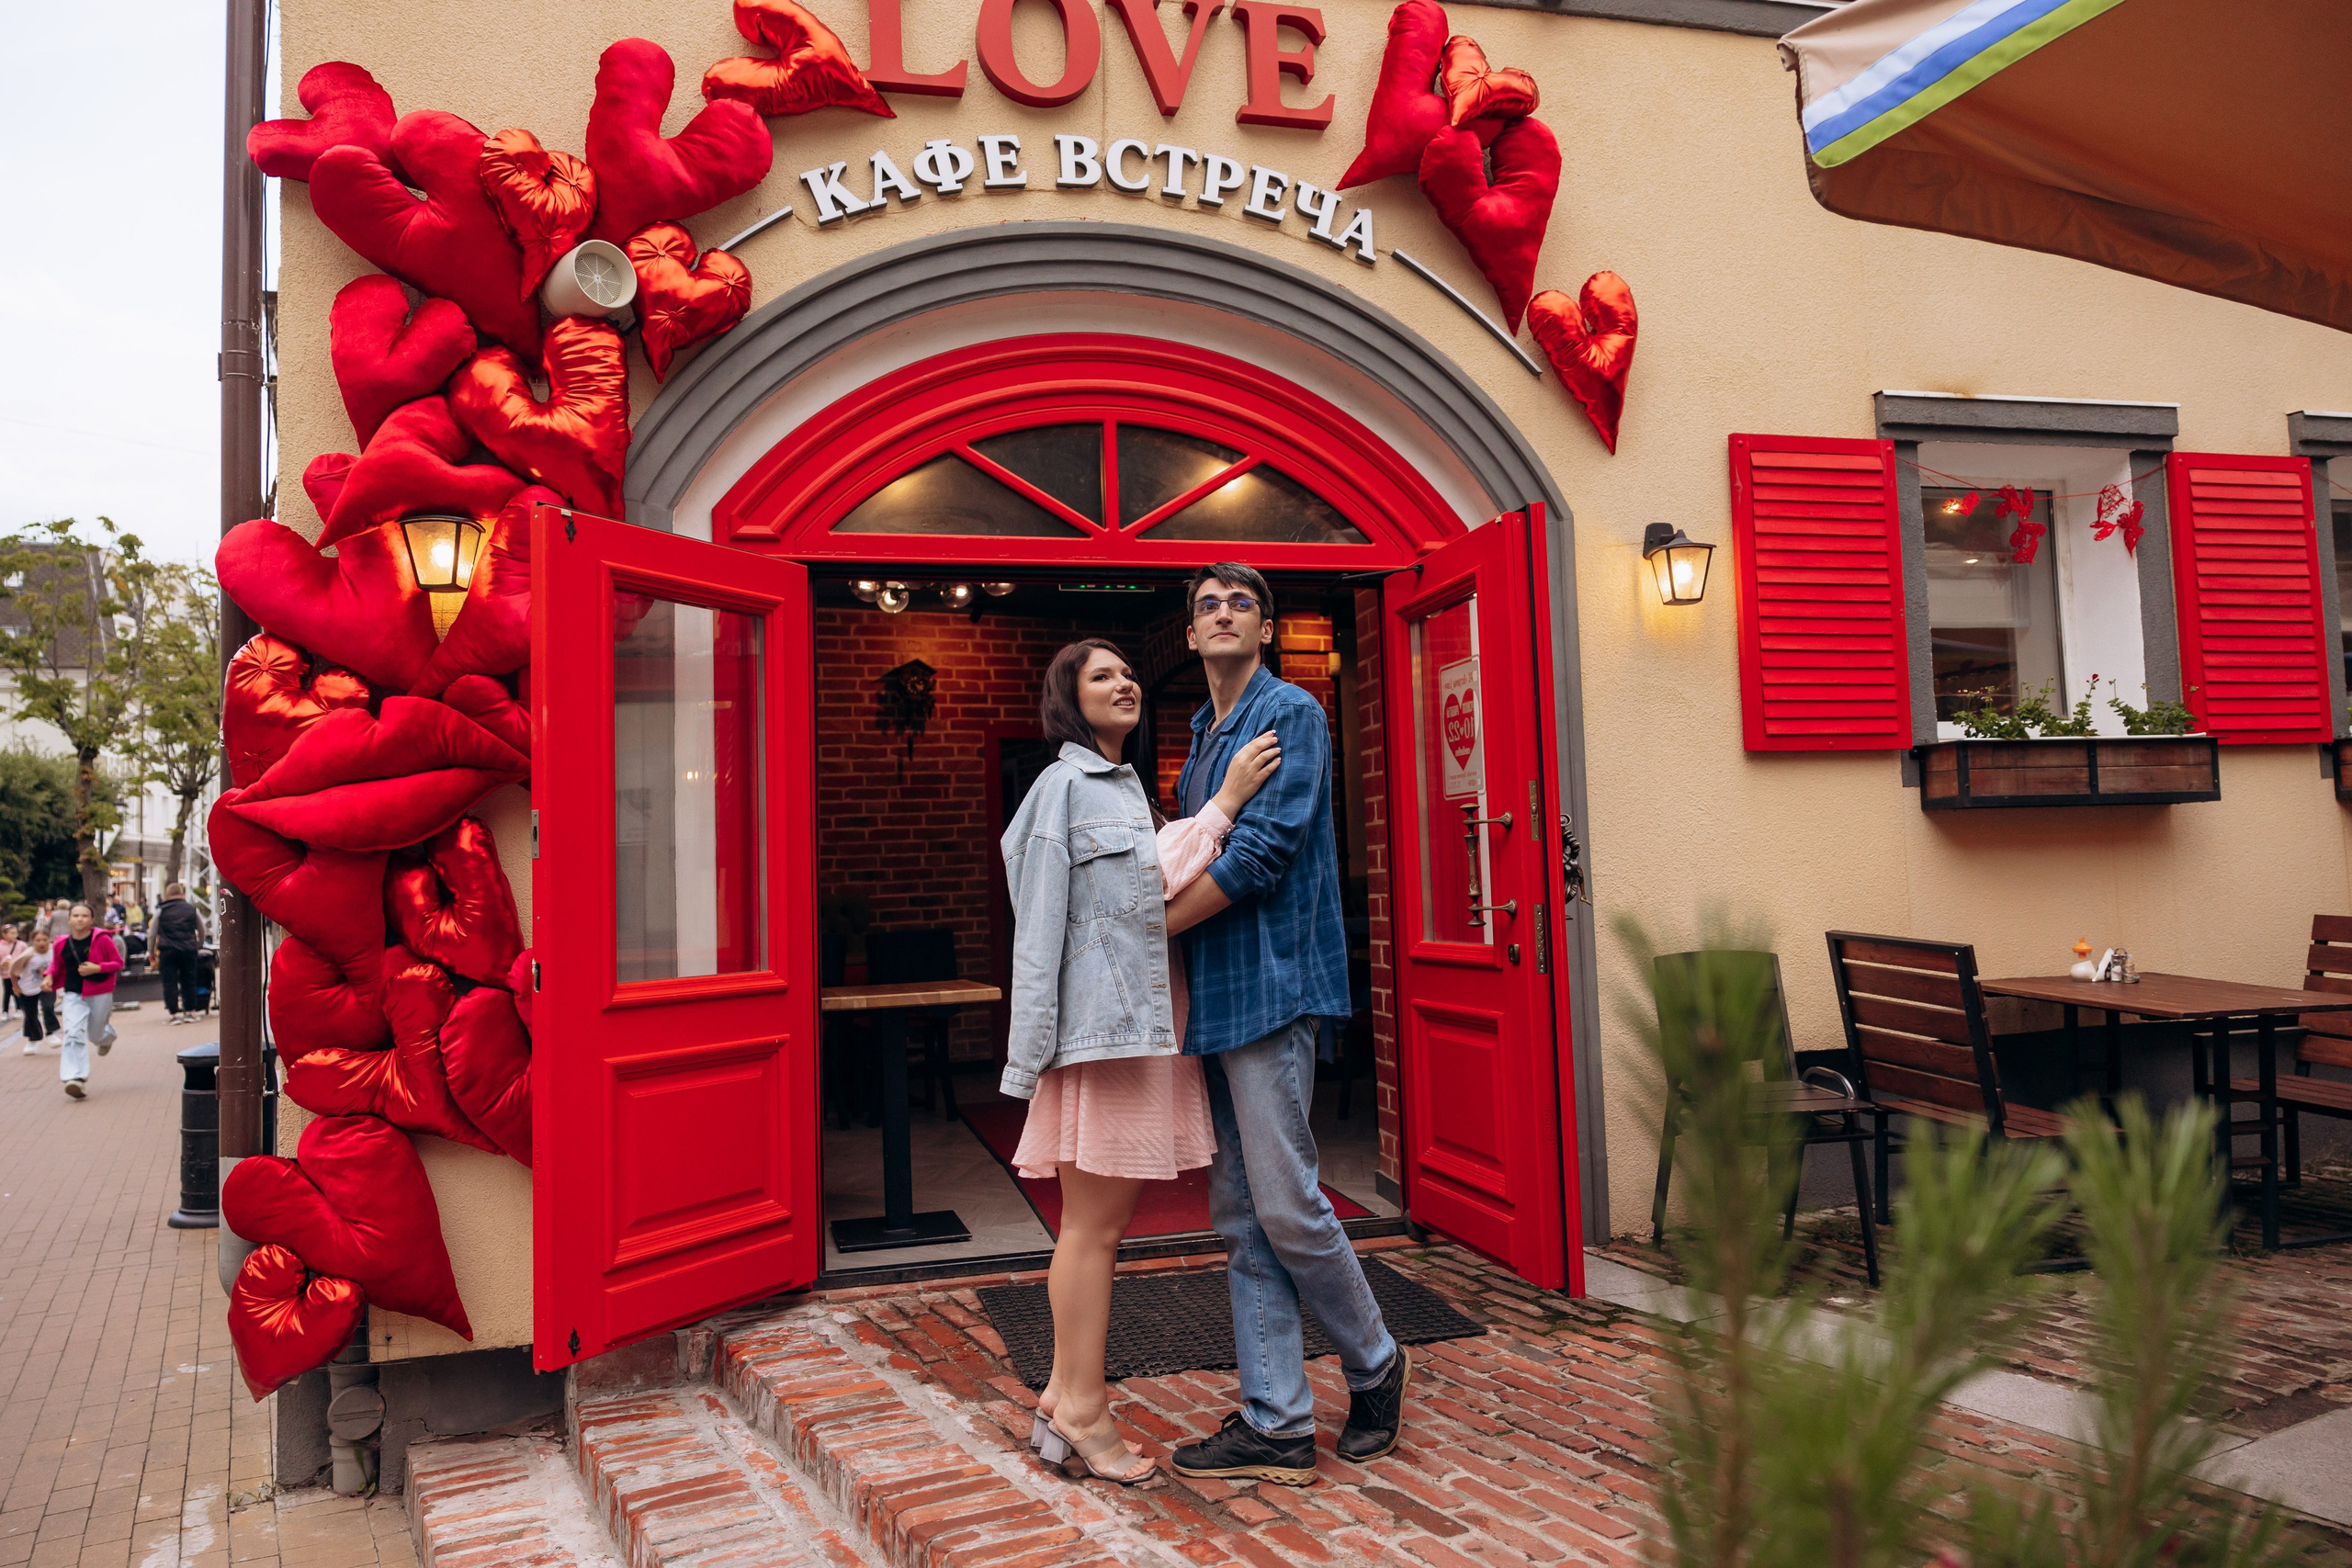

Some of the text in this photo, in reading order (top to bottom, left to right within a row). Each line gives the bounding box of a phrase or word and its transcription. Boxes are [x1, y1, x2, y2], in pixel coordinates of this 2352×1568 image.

[858, 0, 1335, 130] LOVE
[799, 134, 1376, 268] КАФЕ ВСТРЕЧА
